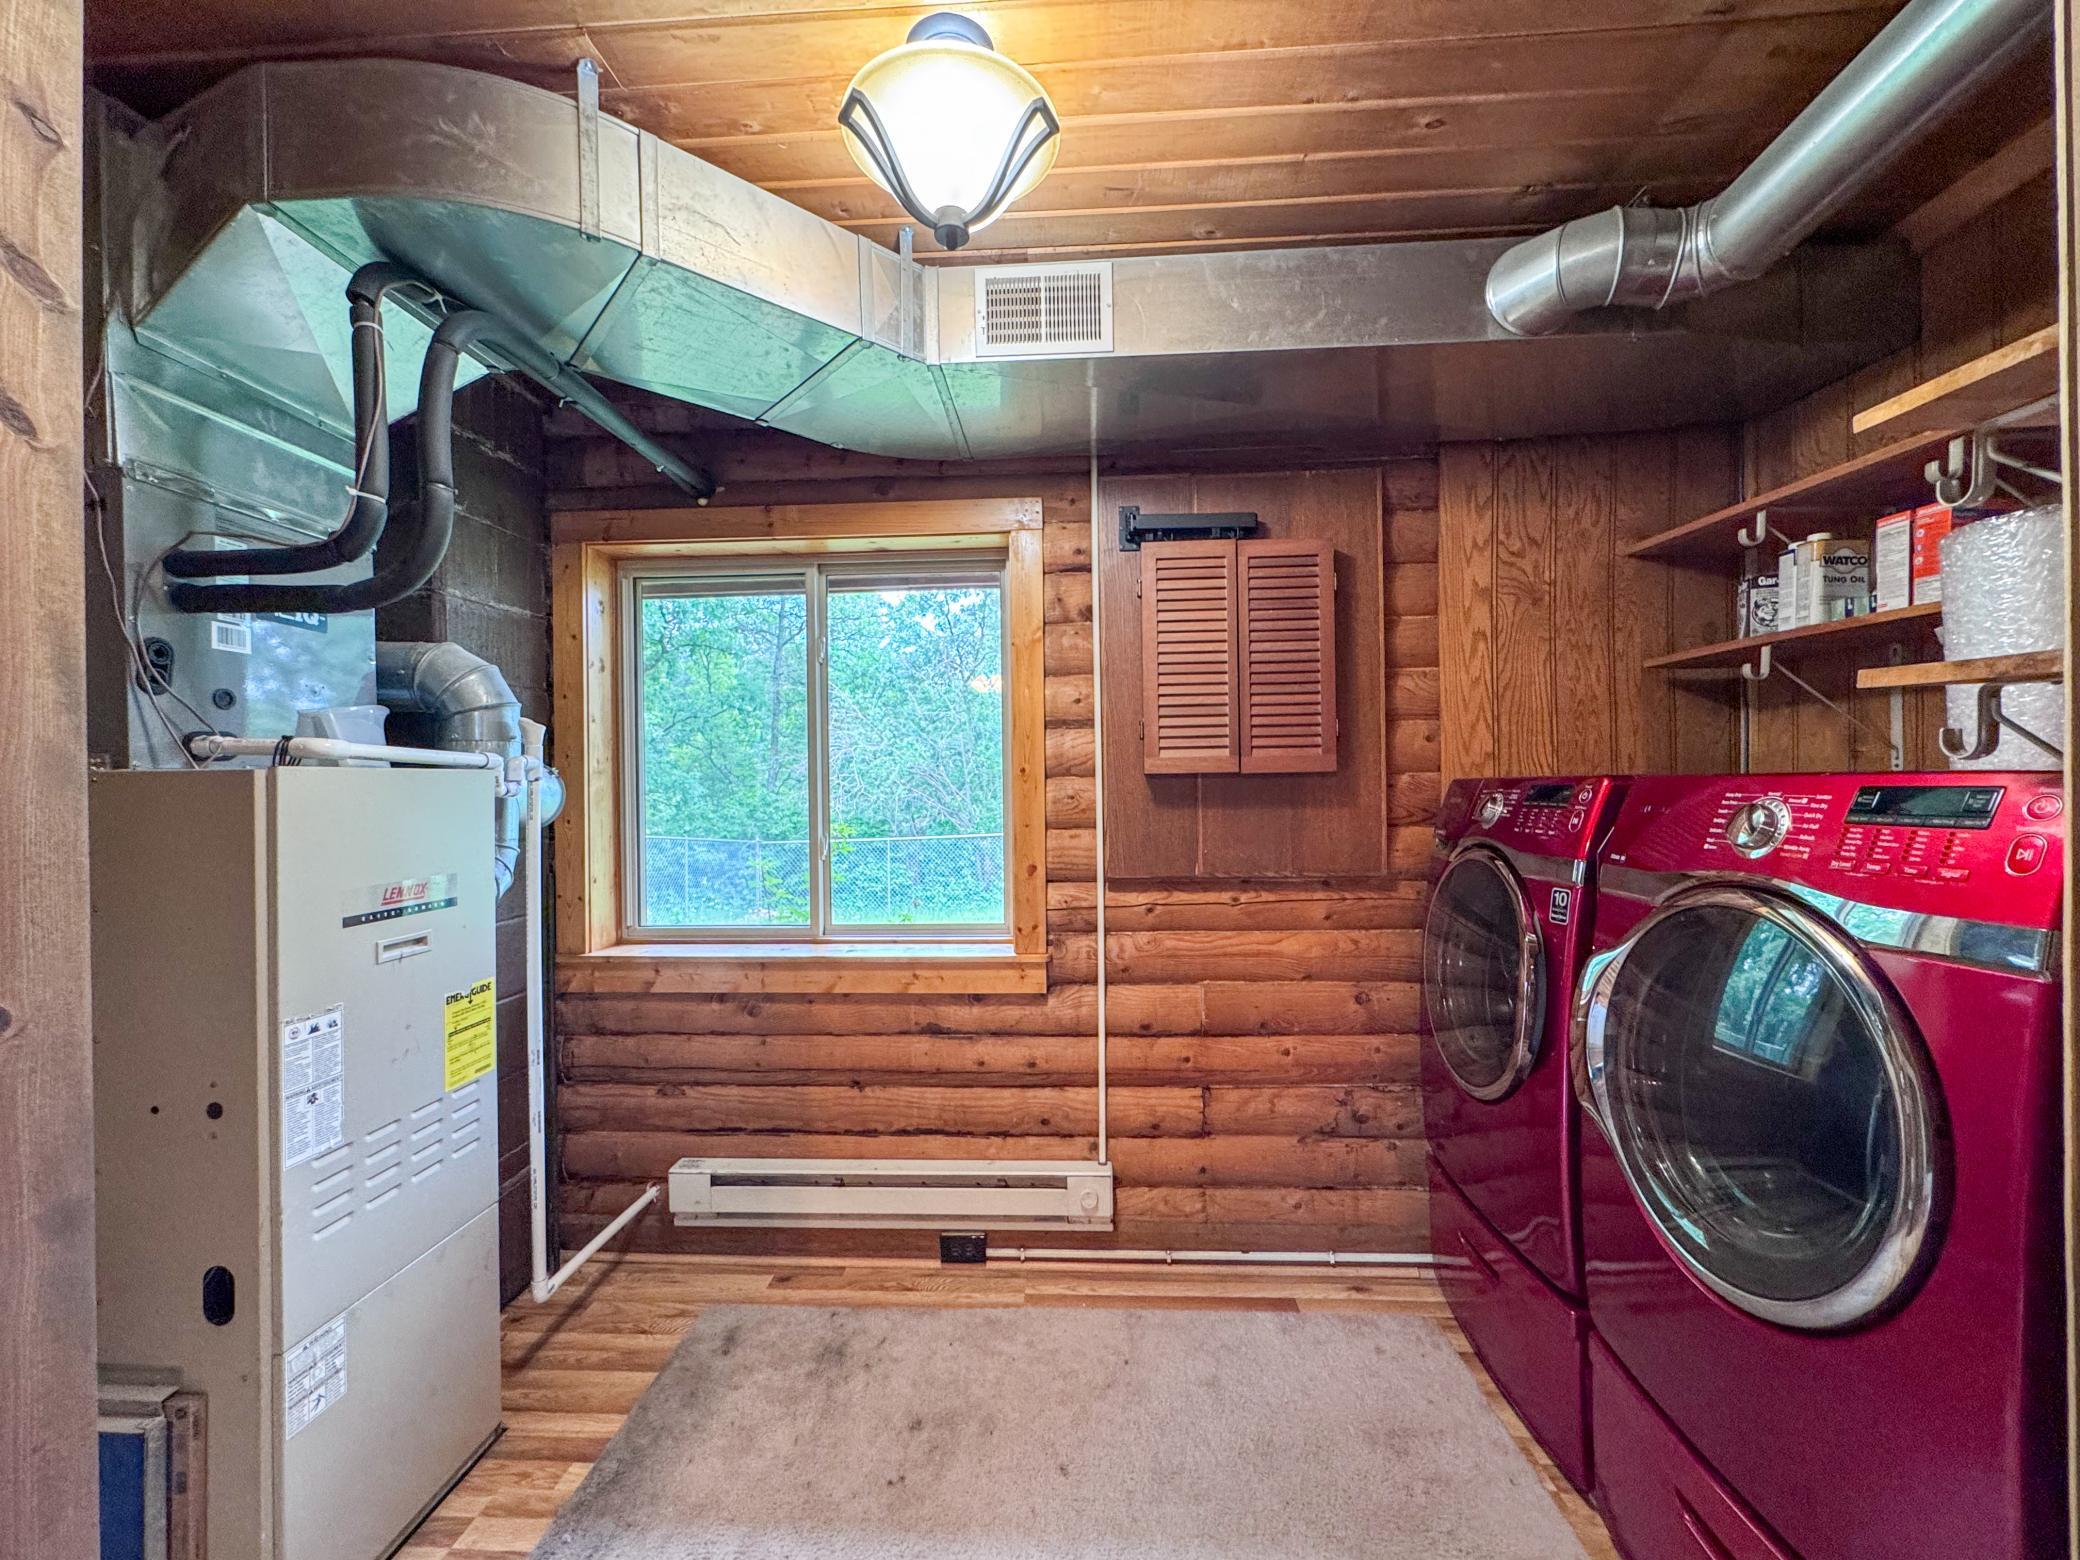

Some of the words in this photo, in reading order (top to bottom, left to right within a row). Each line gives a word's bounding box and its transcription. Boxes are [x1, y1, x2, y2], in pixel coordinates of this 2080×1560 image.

[1822, 555, 1868, 566] WATCO
[1758, 576, 1779, 586] Gar
[1823, 575, 1847, 584] TUNG
[1850, 575, 1866, 583] OIL
[382, 882, 428, 902] LENNOX
[1554, 891, 1568, 907] 10
